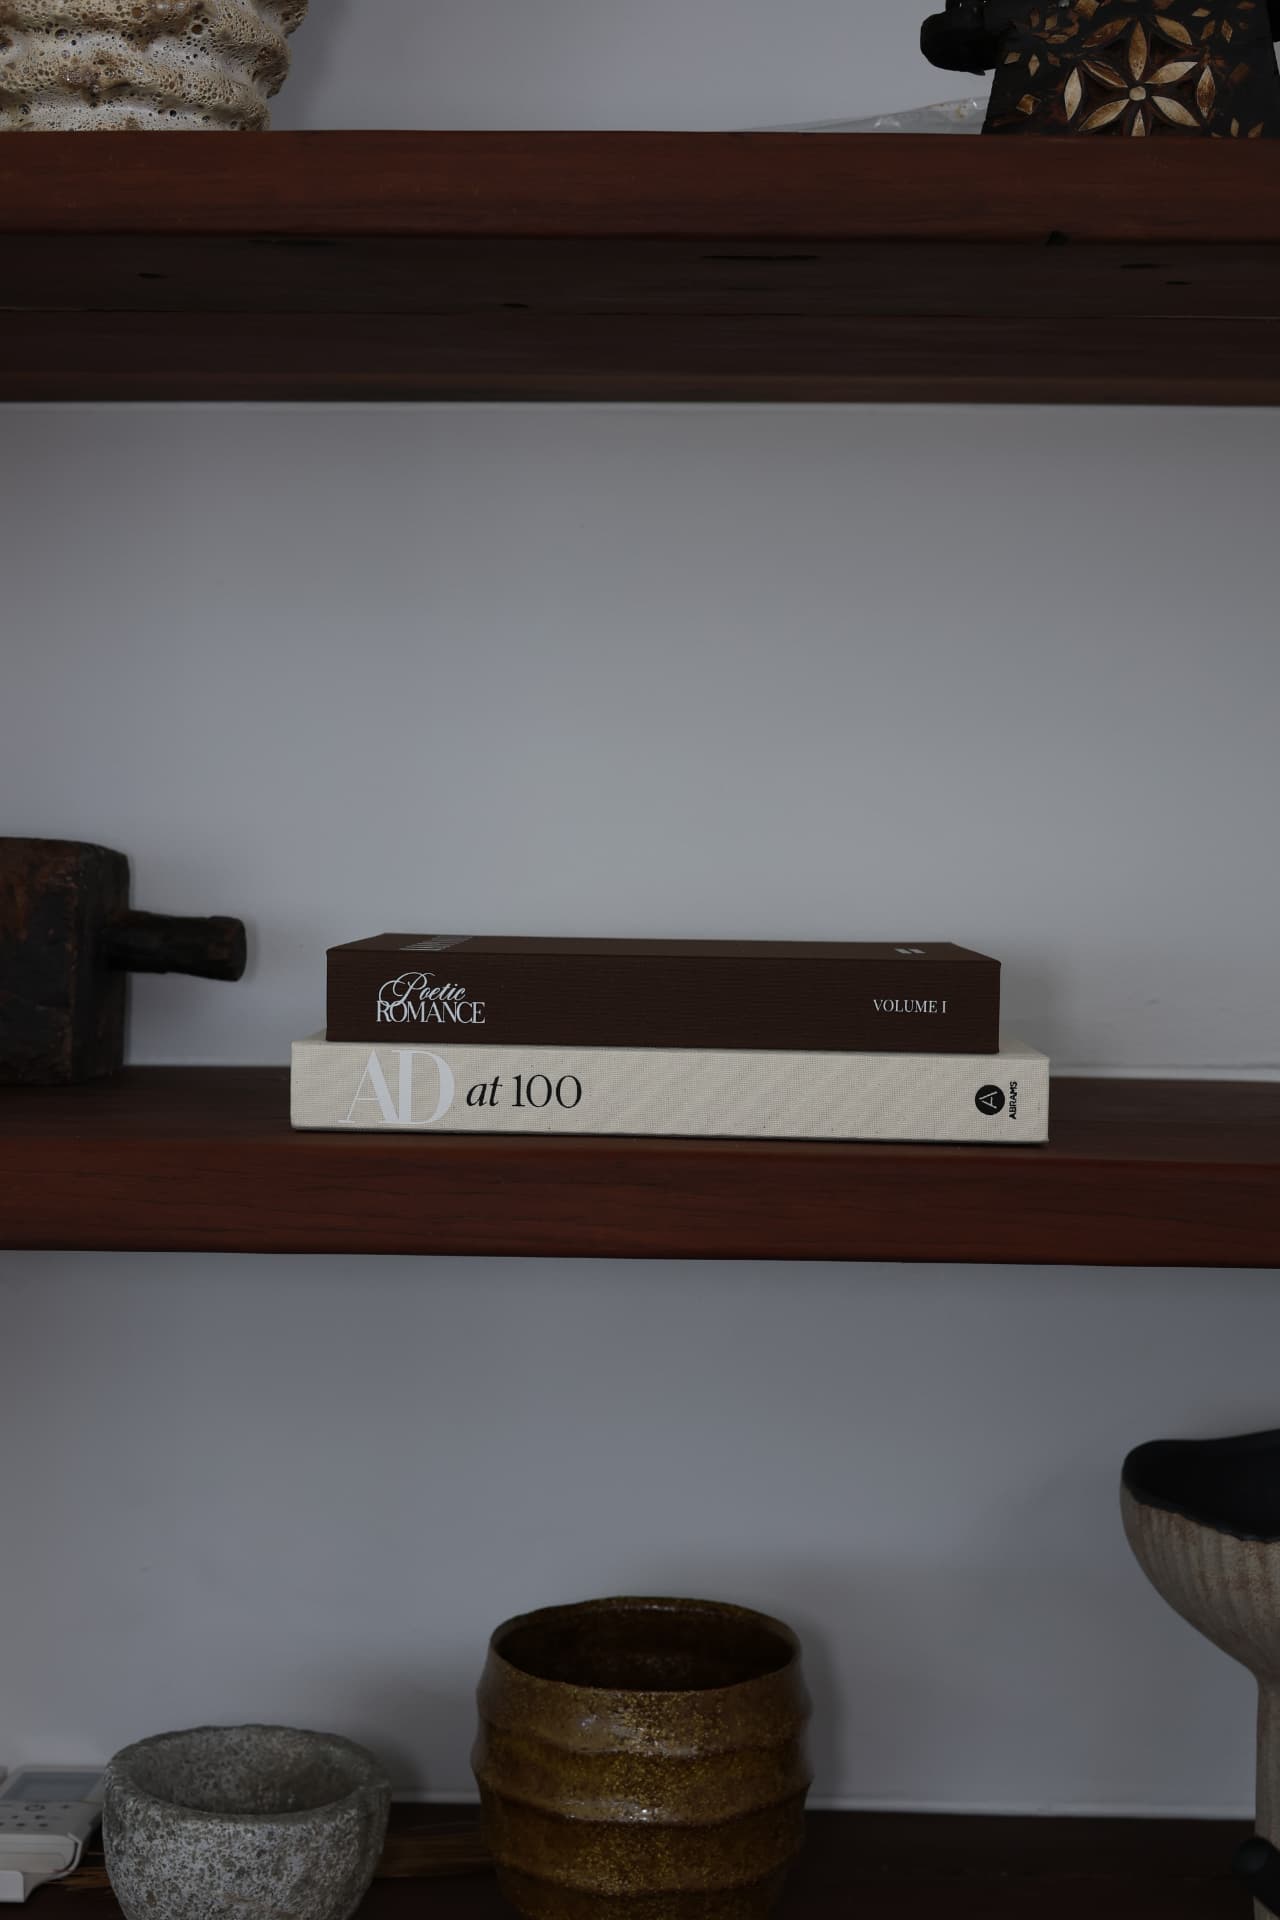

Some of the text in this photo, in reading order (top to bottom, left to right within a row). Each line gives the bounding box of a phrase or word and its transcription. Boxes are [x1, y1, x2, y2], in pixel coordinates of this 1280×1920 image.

[378, 971, 466, 1006] Poetic
[873, 999, 948, 1013] VOLUME I
[376, 1000, 486, 1024] ROMANCE
[338, 1048, 582, 1125] AD at 100
[1008, 1081, 1018, 1120] ABRAMS
